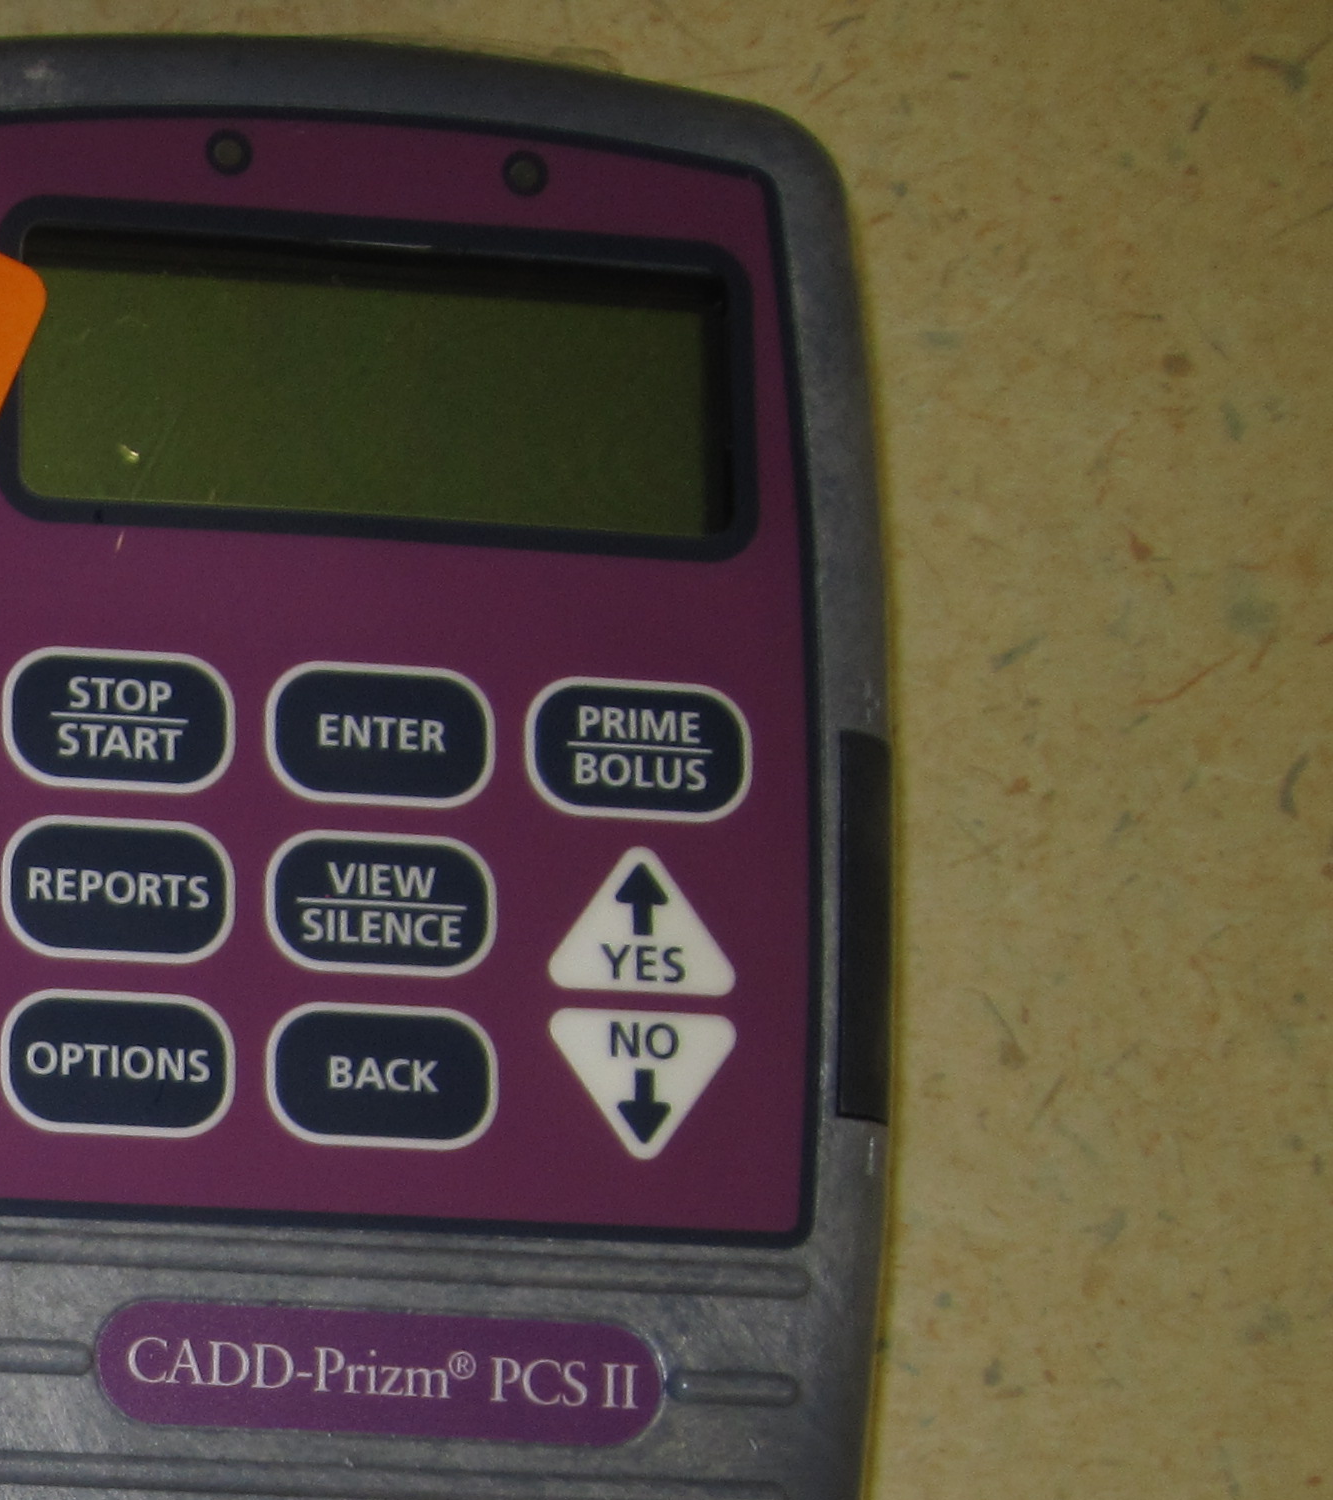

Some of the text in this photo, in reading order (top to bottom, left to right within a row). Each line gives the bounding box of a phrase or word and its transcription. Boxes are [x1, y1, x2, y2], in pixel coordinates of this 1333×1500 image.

[67, 676, 173, 713] STOP
[57, 724, 183, 762] START
[318, 715, 446, 753] ENTER
[577, 705, 701, 743] PRIME
[574, 753, 708, 791] BOLUS
[27, 867, 210, 909] REPORTS
[327, 861, 436, 898] VIEW
[301, 909, 462, 948] SILENCE
[600, 944, 686, 983] YES
[609, 1021, 679, 1060] NO
[25, 1040, 211, 1082] OPTIONS
[328, 1056, 439, 1092] BACK
[490, 1356, 588, 1407] PCS
[604, 1362, 639, 1409] II
